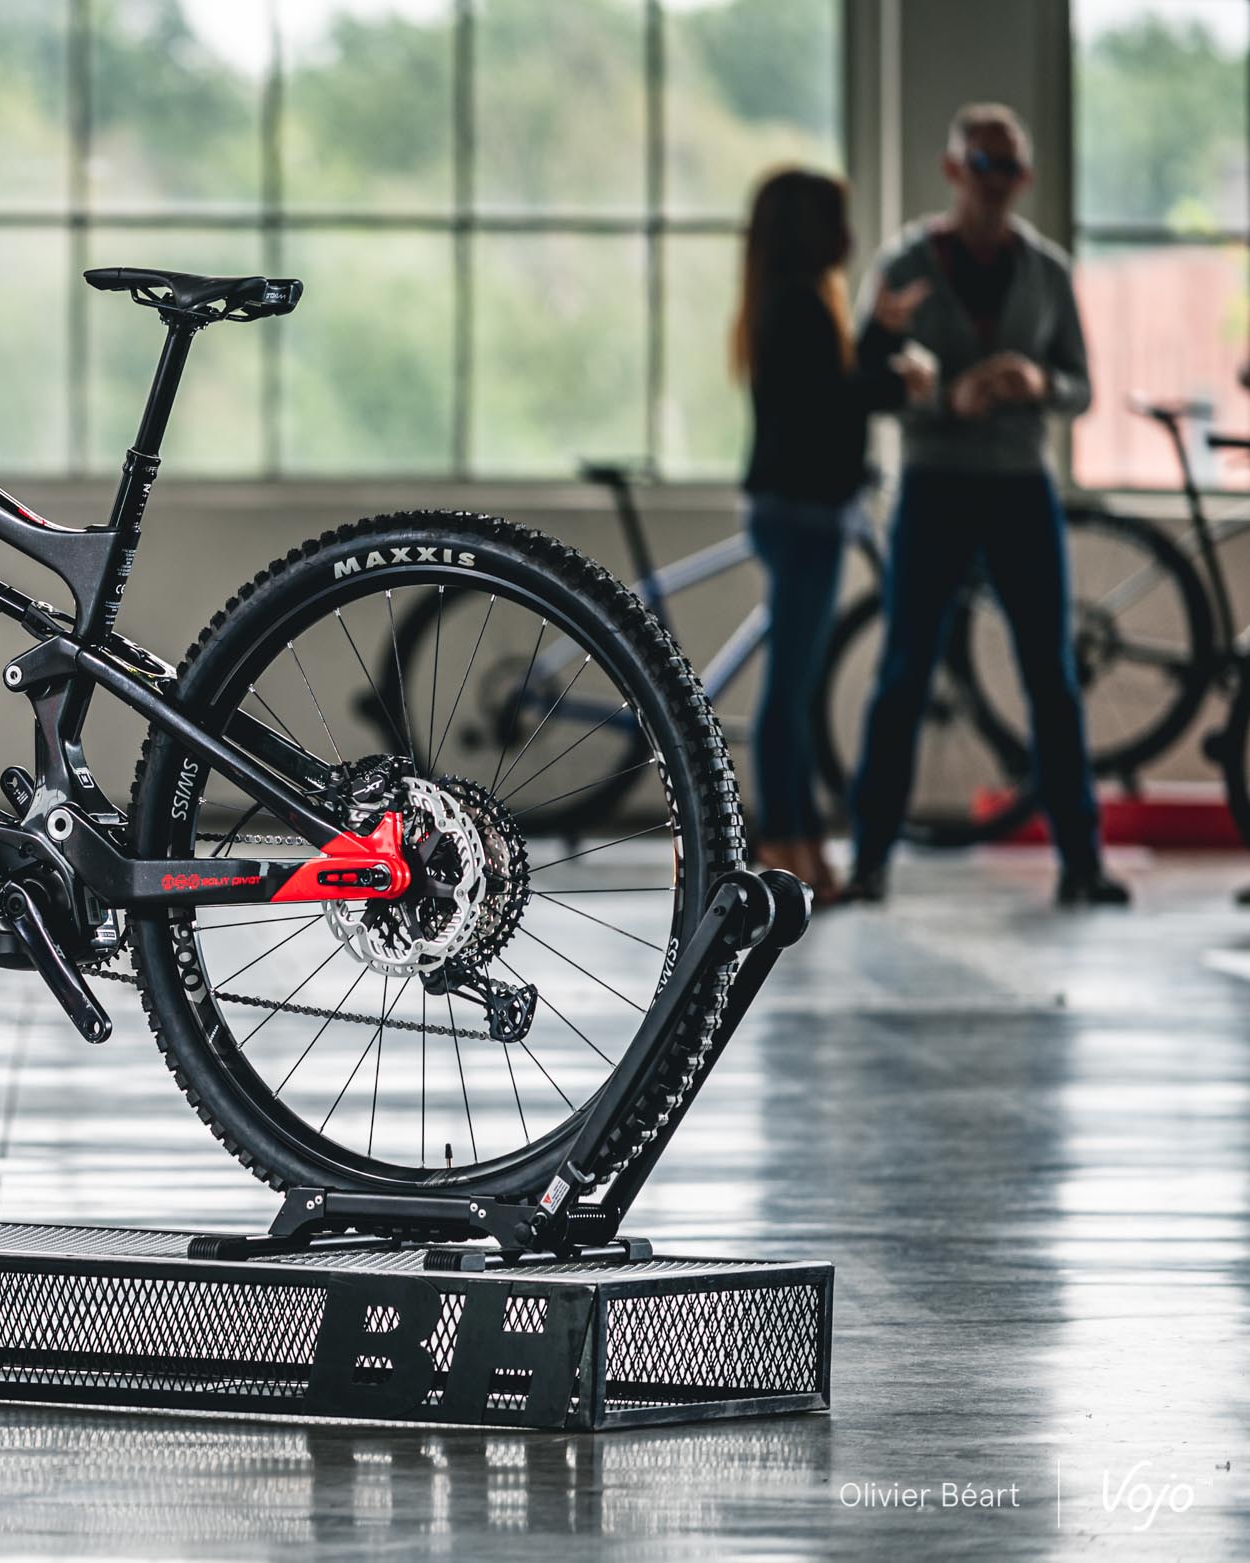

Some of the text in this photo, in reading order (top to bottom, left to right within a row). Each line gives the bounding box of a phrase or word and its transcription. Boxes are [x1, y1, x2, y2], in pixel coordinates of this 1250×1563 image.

[334, 547, 476, 579] MAXXIS
[171, 758, 199, 821] SWISS
[301, 1271, 596, 1430] BH
